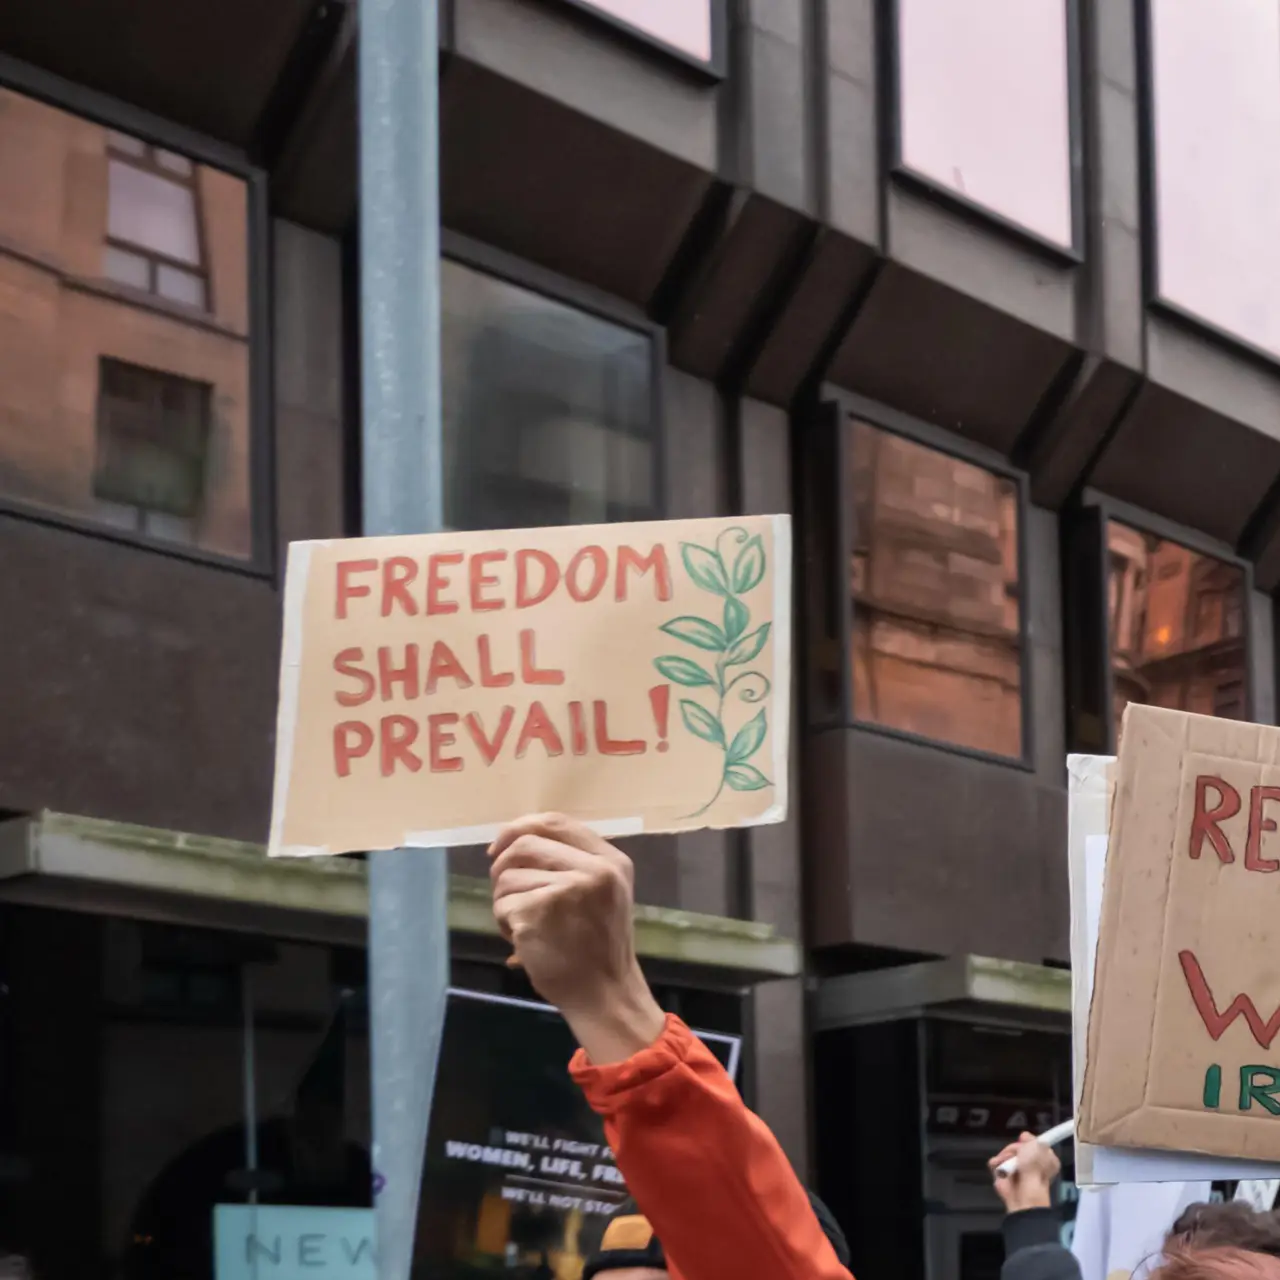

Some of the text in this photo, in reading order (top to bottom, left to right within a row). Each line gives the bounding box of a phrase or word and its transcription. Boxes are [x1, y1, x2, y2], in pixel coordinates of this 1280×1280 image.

[334, 543, 673, 619] FREEDOM
[333, 629, 565, 707] SHALL
[334, 684, 671, 777] PREVAIL!
[445, 1140, 534, 1171] WOMEN,
[540, 1156, 587, 1179] LIFE,
[505, 1131, 549, 1149] WE'LL
[553, 1139, 599, 1157] FIGHT
[502, 1186, 546, 1204] WE'LL
[549, 1194, 582, 1209] NOT
